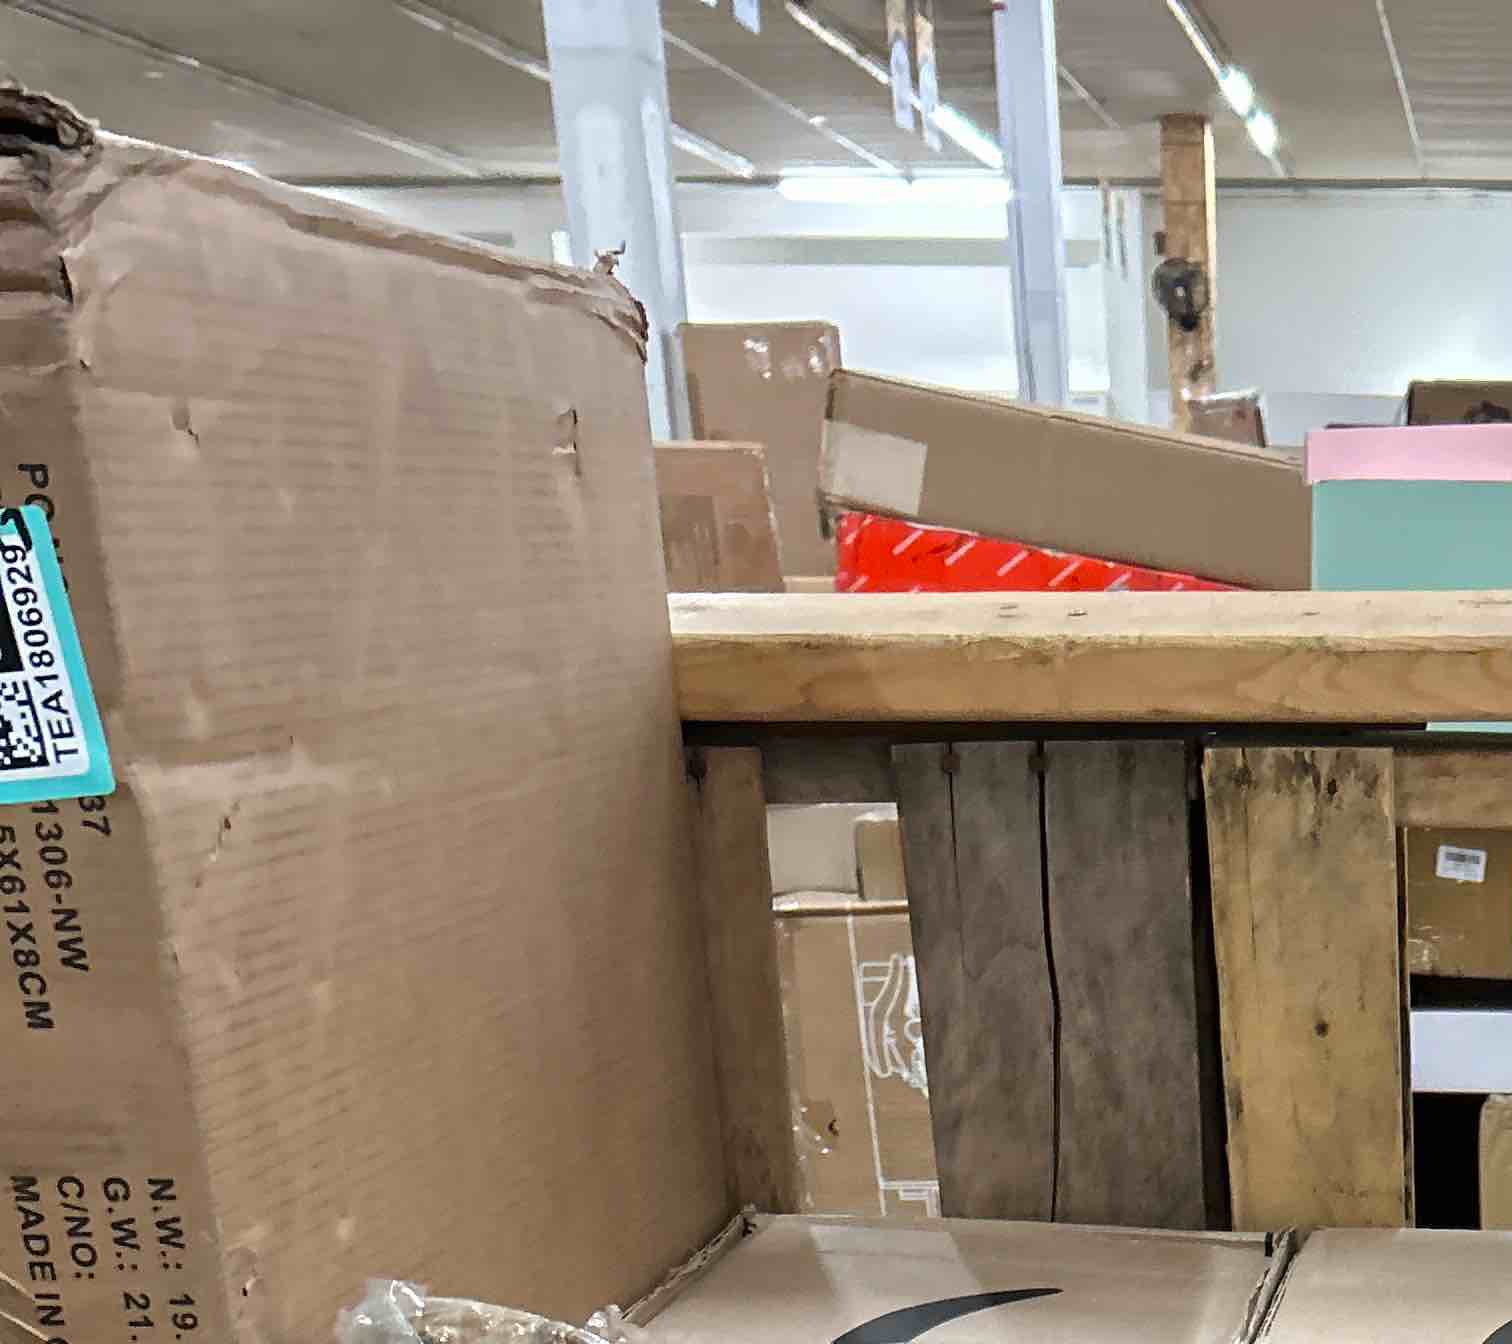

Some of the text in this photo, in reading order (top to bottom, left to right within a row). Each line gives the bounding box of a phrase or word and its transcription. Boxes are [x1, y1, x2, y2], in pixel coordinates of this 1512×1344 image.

[1, 545, 79, 763] TEA1806929
[10, 1176, 57, 1281] MADE
[34, 1293, 65, 1328] IN
[57, 1176, 97, 1279] C/NO:
